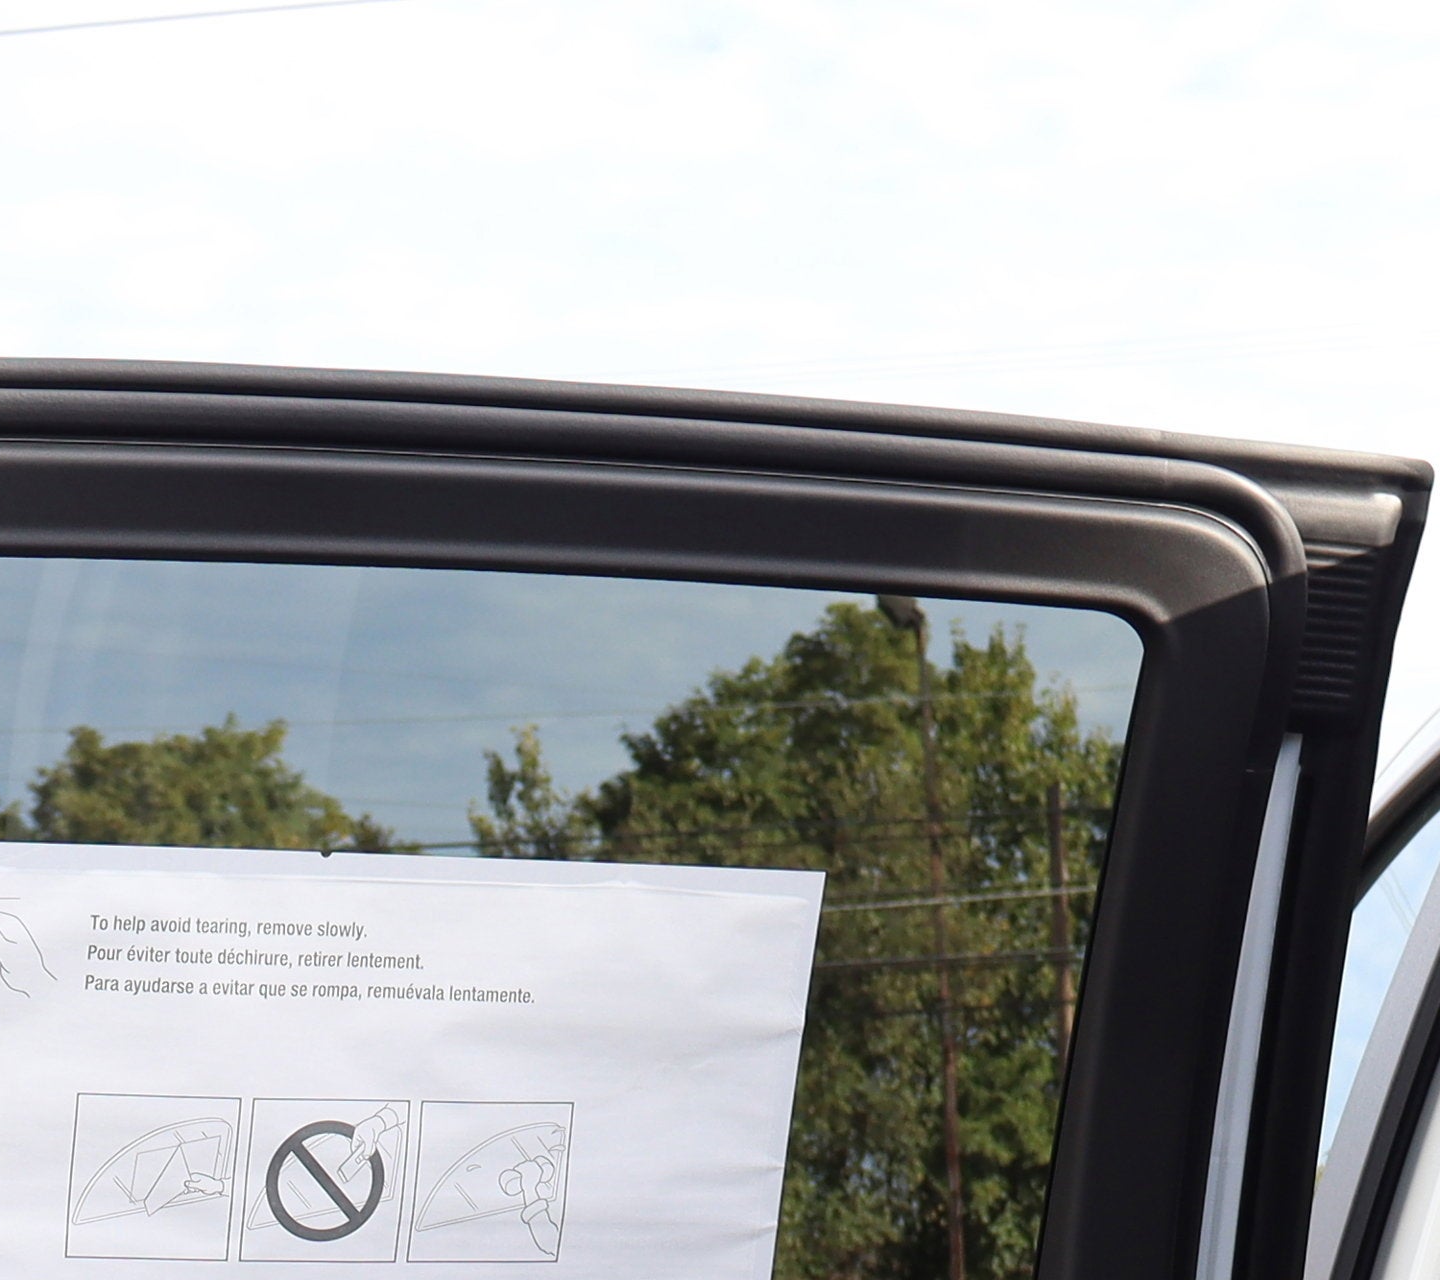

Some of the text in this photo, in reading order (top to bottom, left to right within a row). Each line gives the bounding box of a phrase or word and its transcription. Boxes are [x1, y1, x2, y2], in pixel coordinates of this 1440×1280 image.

[90, 915, 367, 941] To help avoid tearing, remove slowly.
[88, 945, 423, 969] Pour éviter toute déchirure, retirer lentement.
[85, 975, 534, 1003] Para ayudarse a evitar que se rompa, remuévala lentamente.
